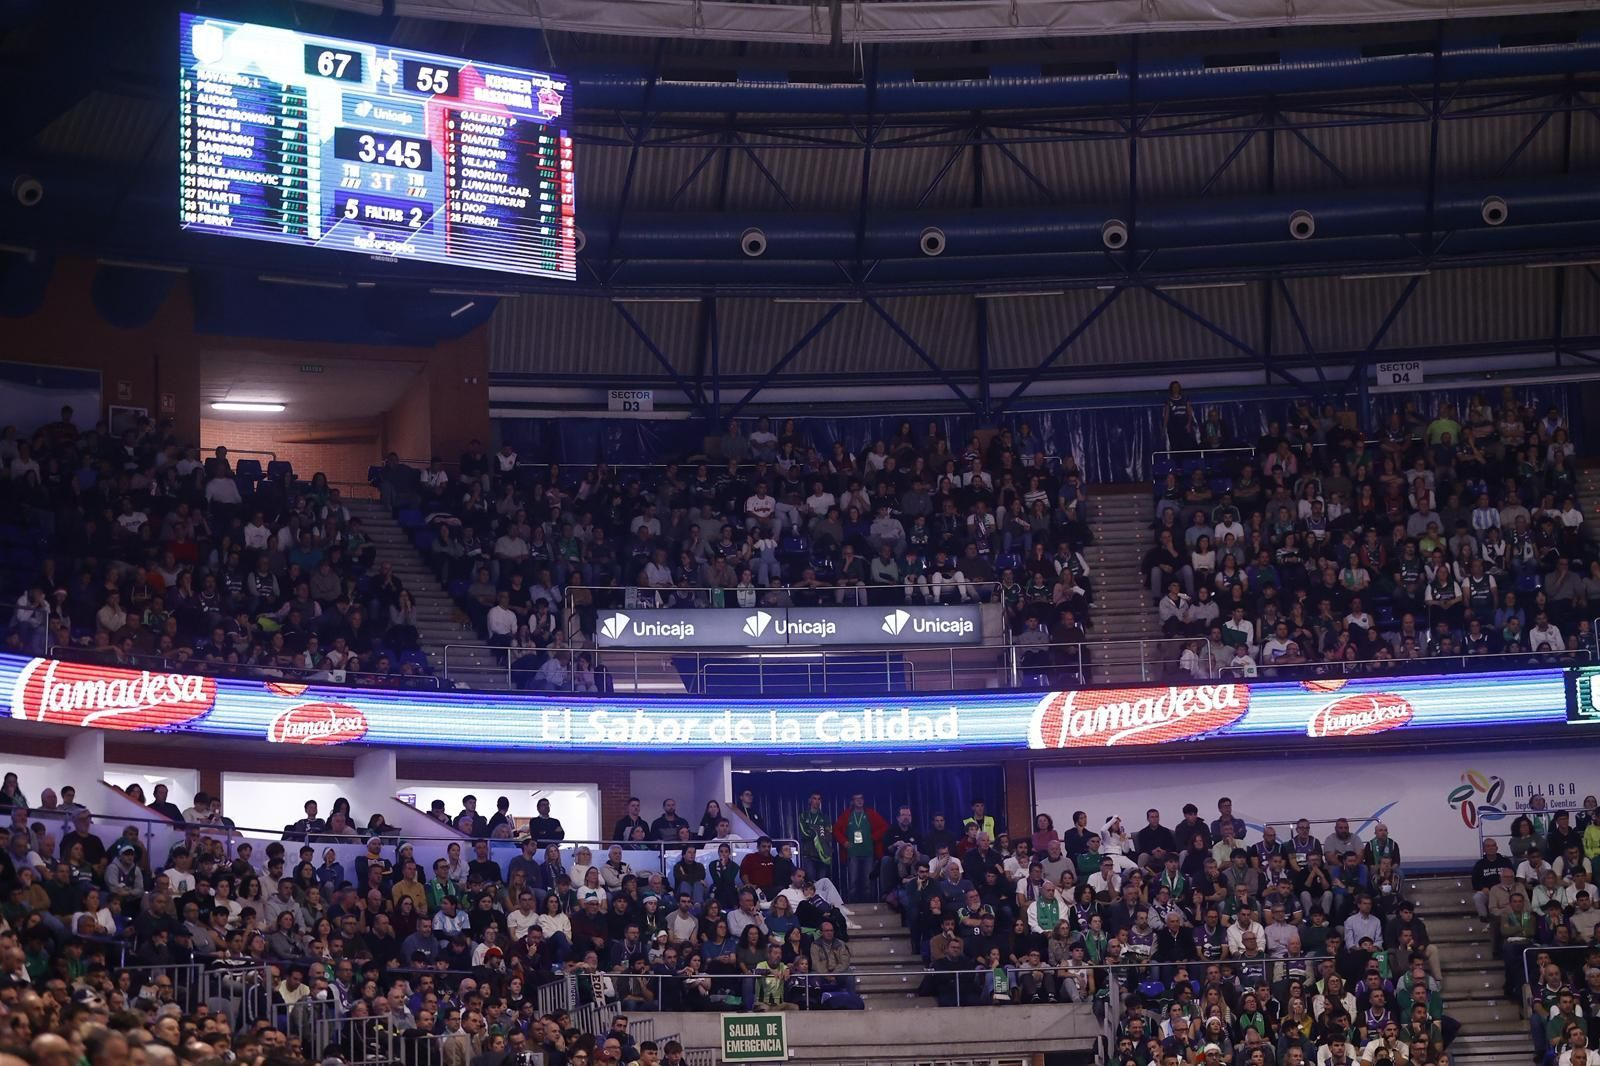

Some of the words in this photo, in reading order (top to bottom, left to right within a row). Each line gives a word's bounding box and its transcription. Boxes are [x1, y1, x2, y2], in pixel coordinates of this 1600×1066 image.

[317, 51, 352, 78] 67
[416, 67, 449, 94] 55
[358, 134, 422, 169] 3:45
[461, 156, 497, 170] VILLAR
[370, 171, 395, 191] 3T
[344, 198, 359, 219] 5
[364, 204, 404, 222] FALTAS
[409, 207, 423, 228] 2
[1380, 362, 1420, 372] SECTOR
[1393, 373, 1410, 384] D4
[611, 391, 650, 400] SECTOR
[623, 400, 640, 412] D3
[633, 621, 695, 640] Unicaja
[775, 619, 837, 639] Unicaja
[913, 617, 974, 637] Unicaja
[11, 656, 207, 722] Famadesa
[267, 706, 364, 744] Famadesa
[541, 708, 572, 742] El
[588, 708, 702, 743] Sabor
[708, 708, 756, 742] de
[770, 709, 799, 742] la
[815, 706, 959, 741] Calidad
[1028, 683, 1241, 748] Famadesa
[1306, 696, 1409, 738] Famadesa
[1514, 781, 1576, 798] MÁLAGA
[973, 927, 980, 936] 9
[729, 1023, 760, 1037] SALIDA
[766, 1023, 778, 1036] DE
[726, 1039, 782, 1053] EMERGENCIA
